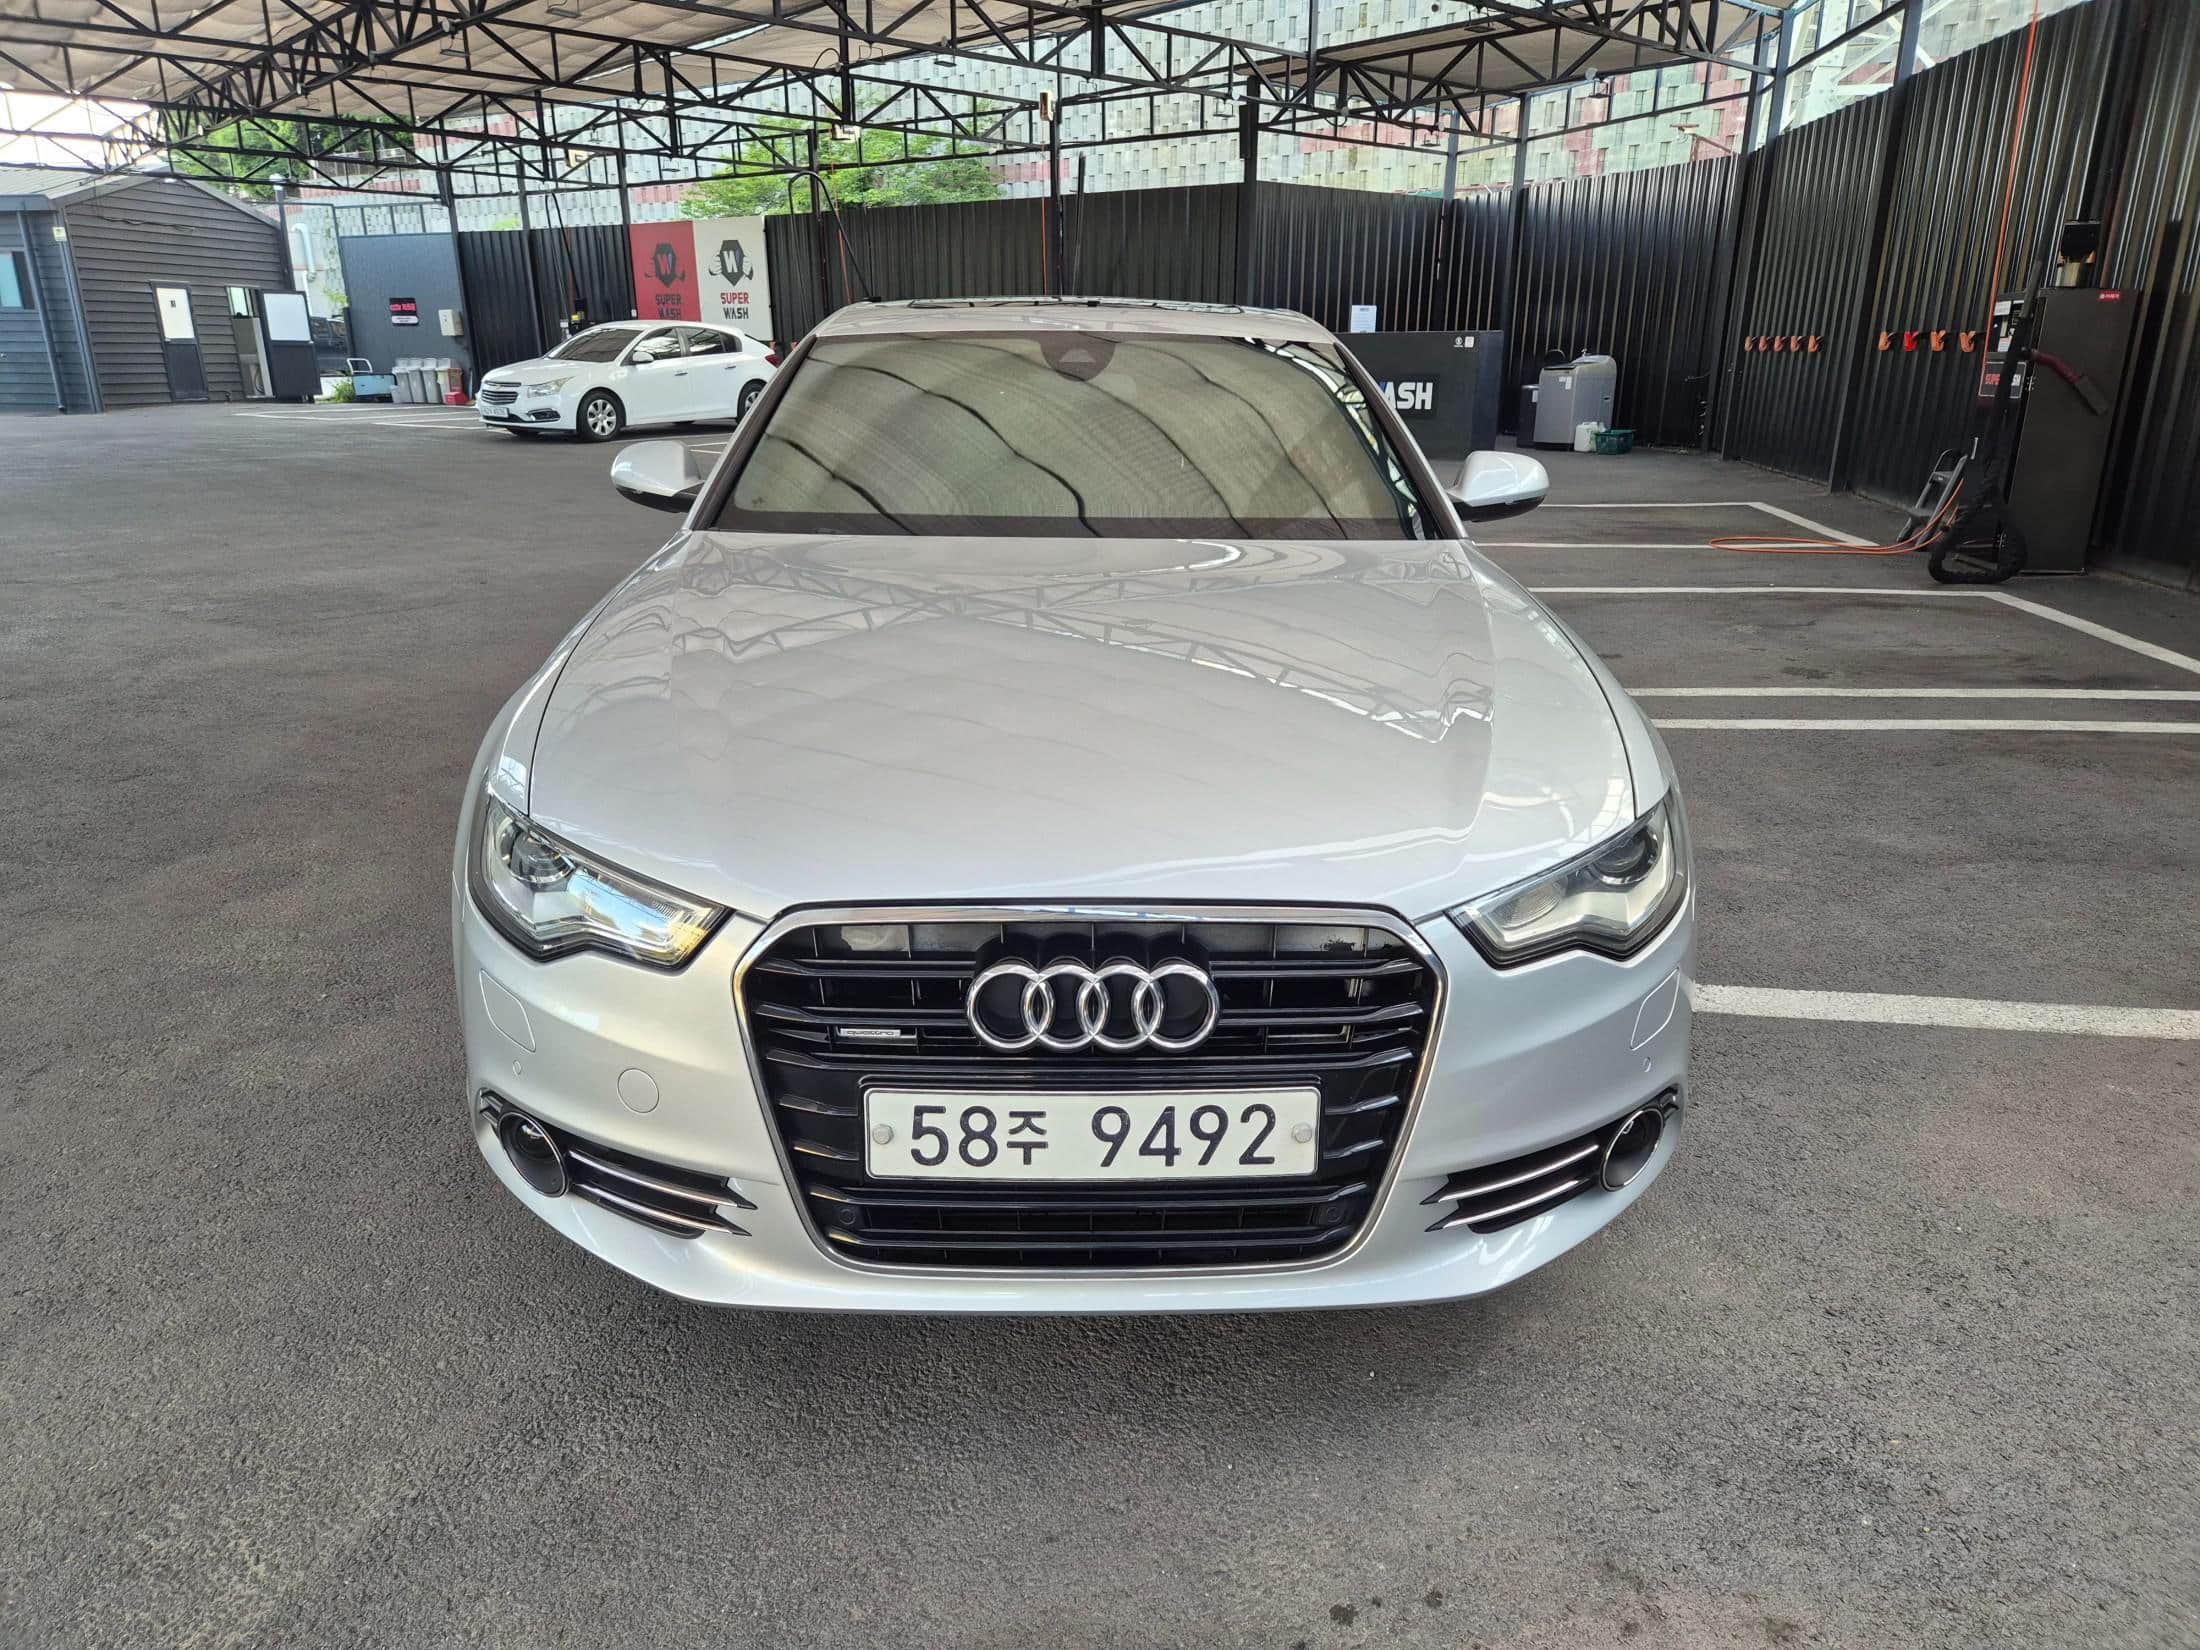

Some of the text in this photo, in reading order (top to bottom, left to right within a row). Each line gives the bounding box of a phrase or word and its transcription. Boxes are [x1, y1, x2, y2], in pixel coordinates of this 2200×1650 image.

[656, 294, 682, 305] SUPER
[720, 292, 749, 304] SUPER
[658, 308, 682, 320] WASH
[723, 307, 749, 319] WASH
[1379, 381, 1433, 410] ASH
[911, 1103, 1276, 1167] 58주 9492
